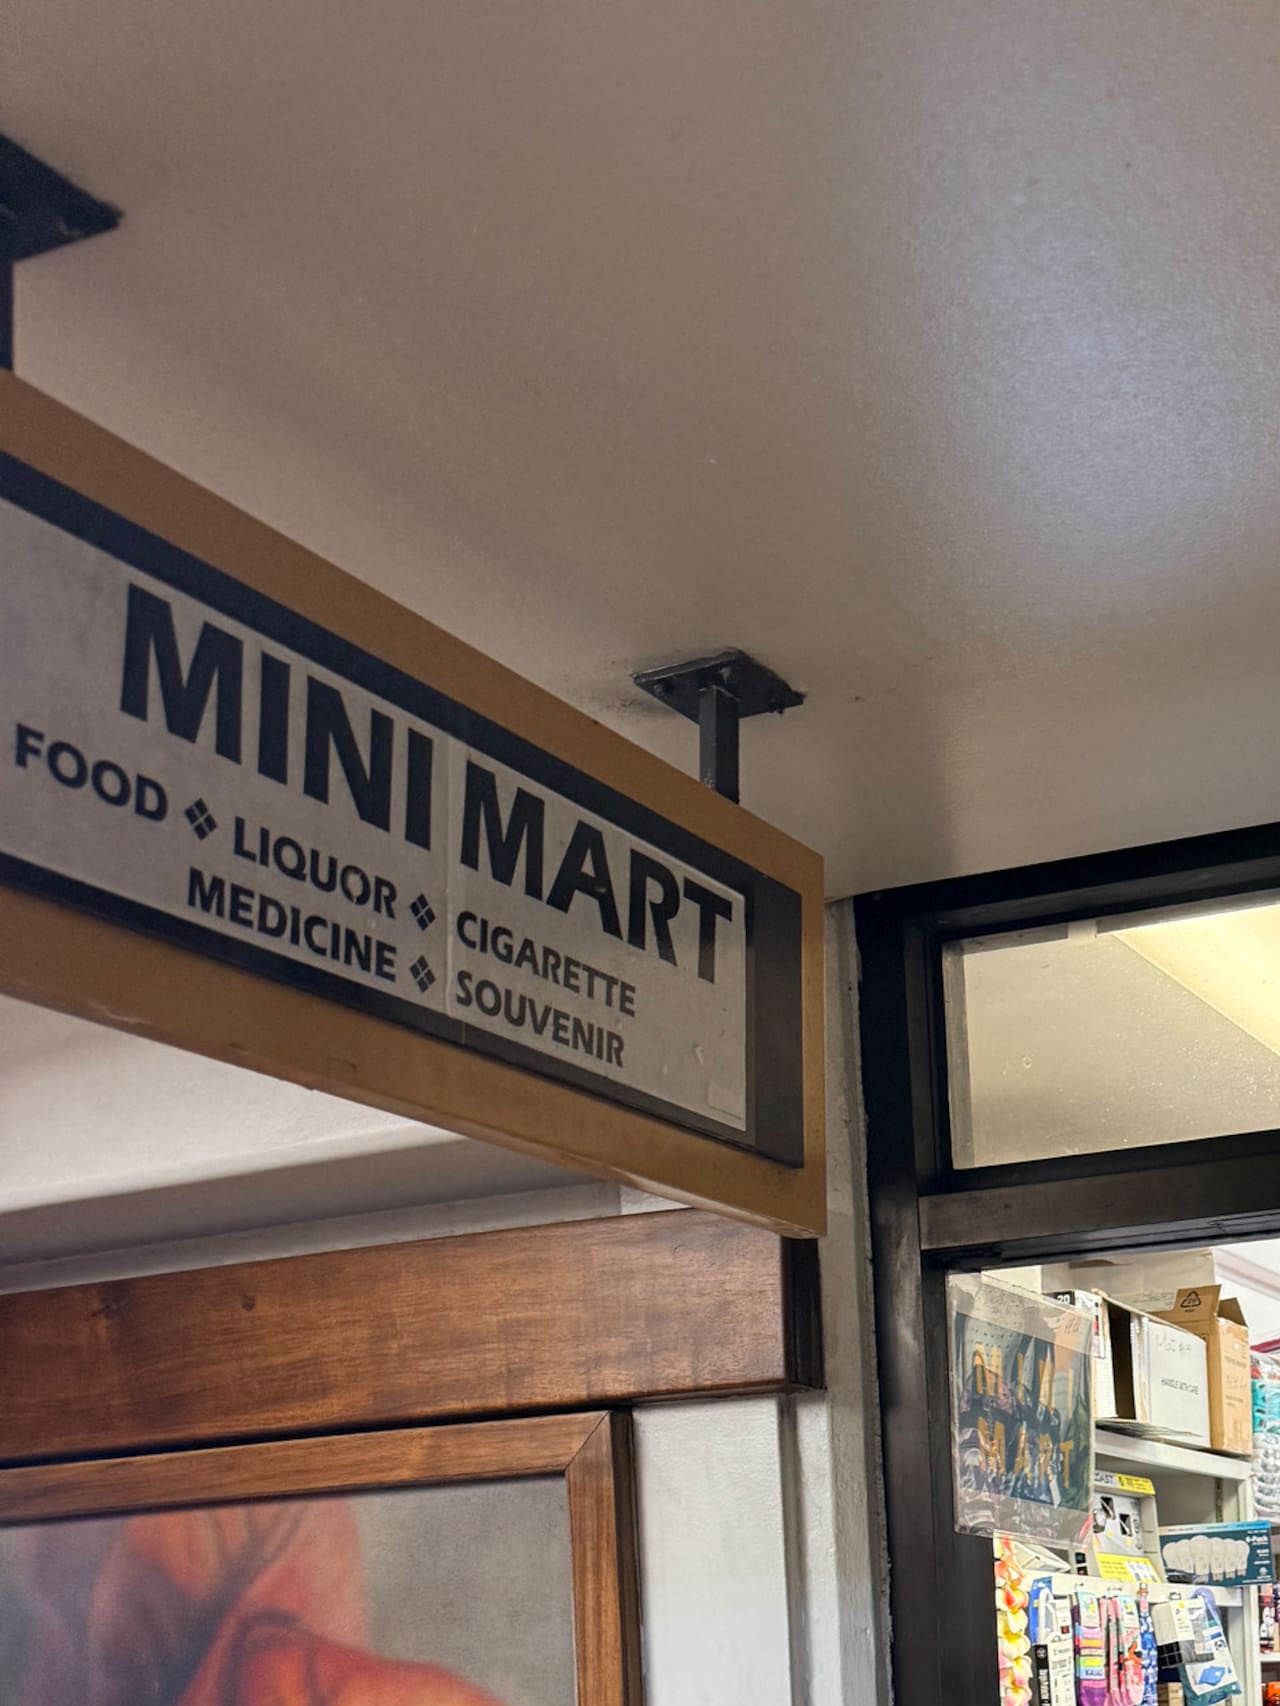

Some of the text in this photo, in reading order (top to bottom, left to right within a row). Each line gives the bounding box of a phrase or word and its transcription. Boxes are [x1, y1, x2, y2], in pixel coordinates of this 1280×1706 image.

[14, 723, 637, 1018] FOOD LIQUOR CIGARETTE
[120, 582, 733, 984] MINI MART
[187, 868, 625, 1068] MEDICINE SOUVENIR
[978, 1416, 1074, 1488] MART
